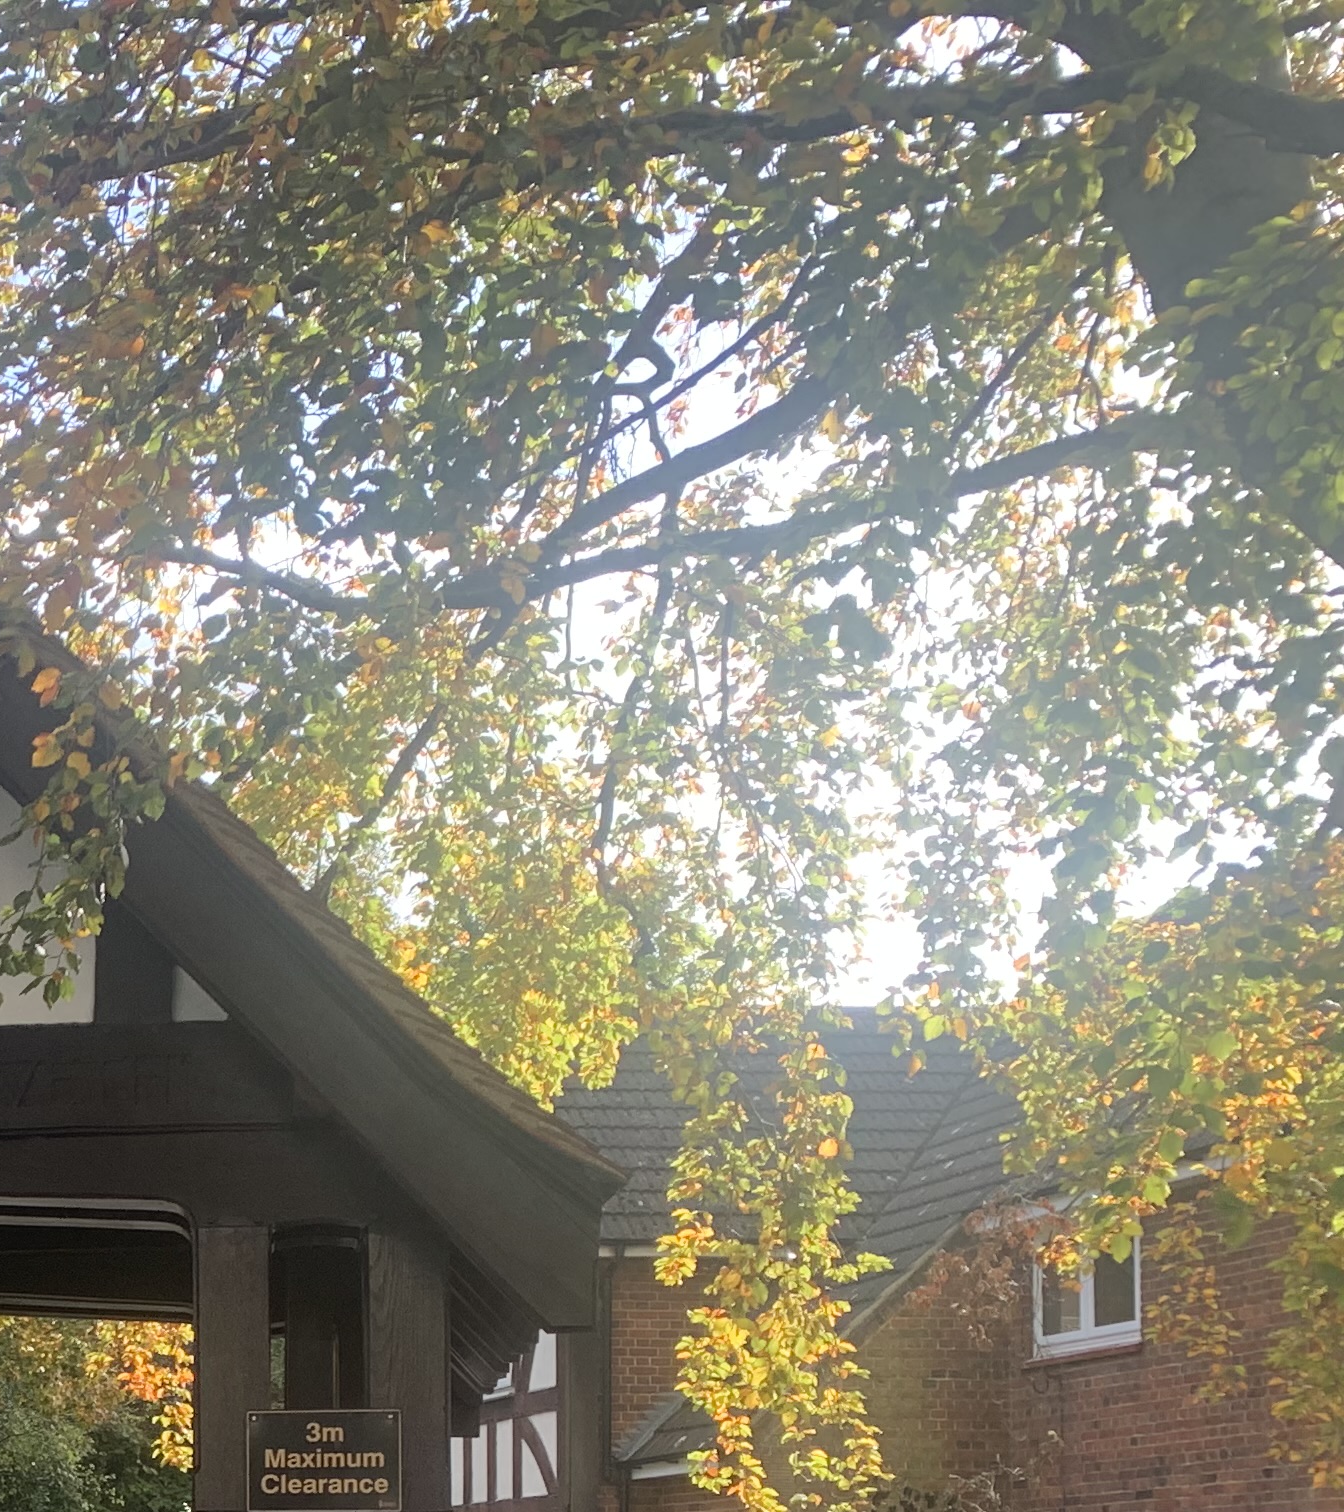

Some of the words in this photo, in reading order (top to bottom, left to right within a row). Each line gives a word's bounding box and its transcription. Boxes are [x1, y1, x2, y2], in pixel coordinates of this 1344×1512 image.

[305, 1422, 344, 1443] 3m
[264, 1448, 385, 1468] Maximum
[260, 1474, 389, 1494] Clearance
